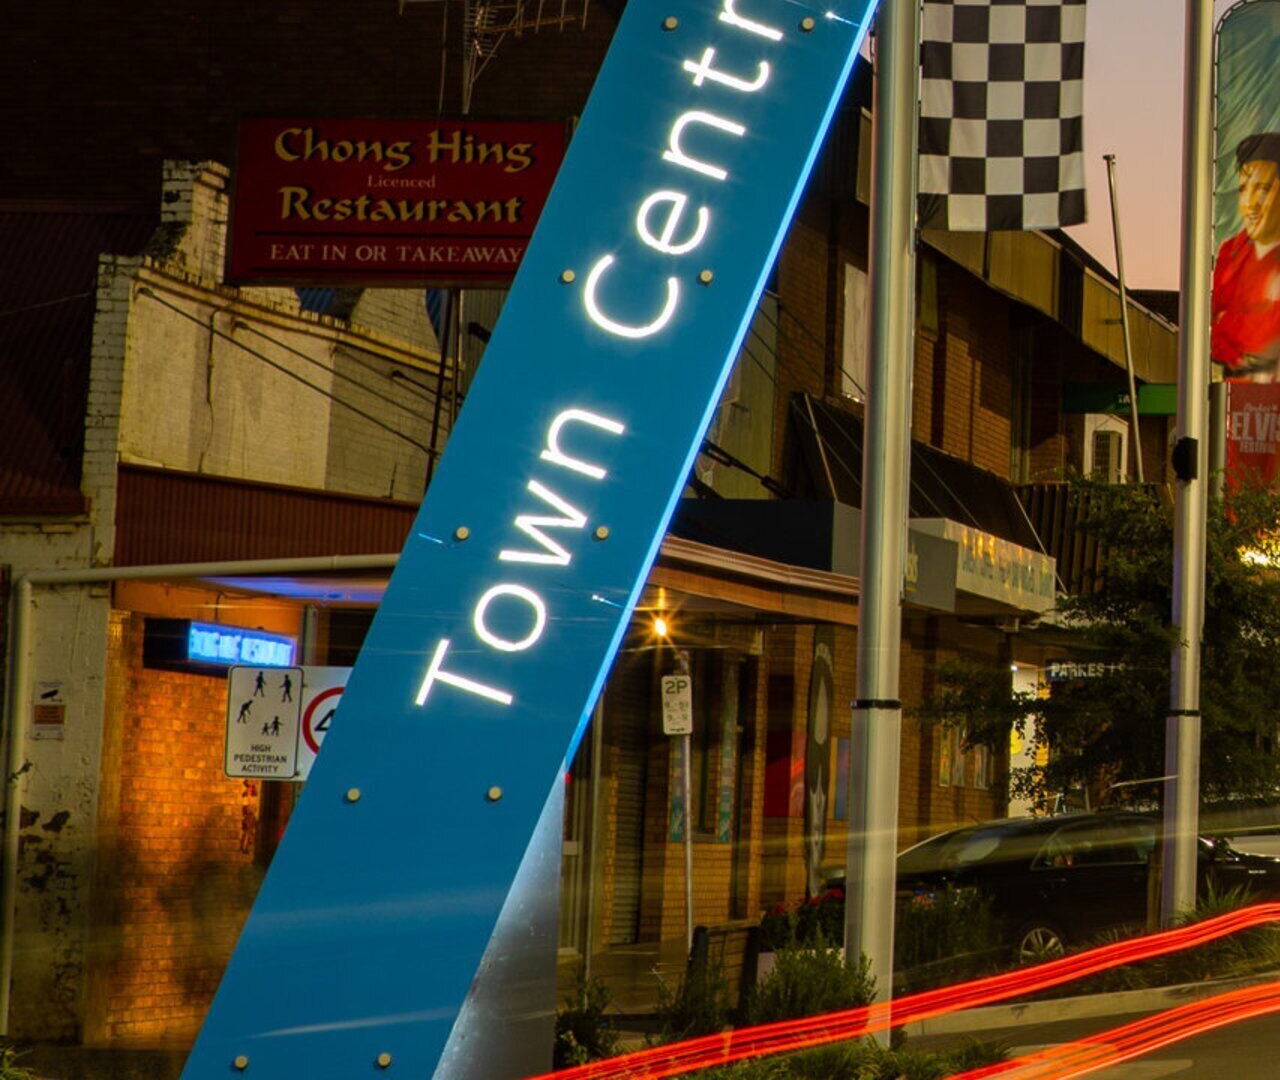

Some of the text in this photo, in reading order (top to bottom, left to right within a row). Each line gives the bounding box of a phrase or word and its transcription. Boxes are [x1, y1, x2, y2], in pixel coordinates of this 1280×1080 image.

[273, 127, 535, 173] Chong Hing
[367, 174, 437, 189] Licenced
[277, 186, 525, 224] Restaurant
[270, 243, 523, 264] EAT IN OR TAKEAWAY
[414, 407, 626, 707] Town
[1050, 662, 1105, 677] PARKES
[665, 680, 687, 694] 2P
[250, 744, 271, 752] HIGH
[234, 754, 287, 763] PEDESTRIAN
[241, 764, 279, 773] ACTIVITY
